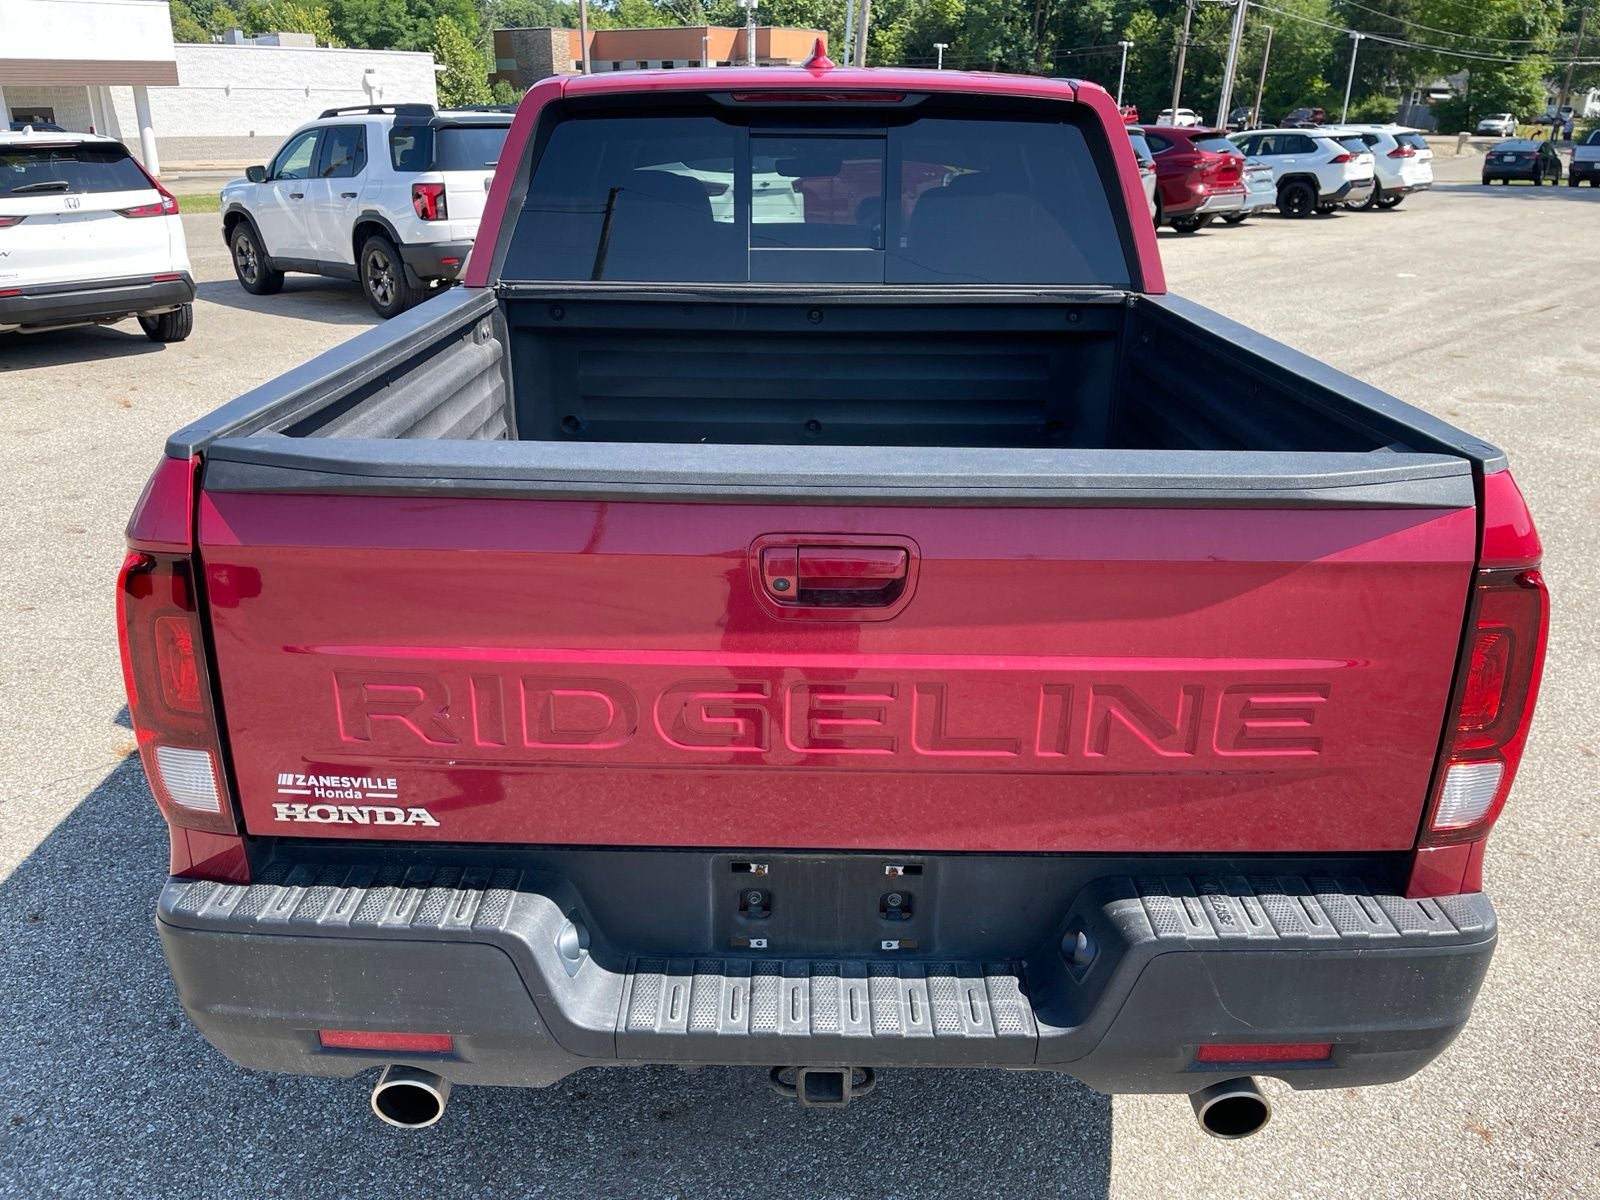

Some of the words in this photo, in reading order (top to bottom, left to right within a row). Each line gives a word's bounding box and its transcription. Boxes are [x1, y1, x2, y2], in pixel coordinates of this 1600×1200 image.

[332, 669, 1331, 757] RIDGELINE
[294, 774, 398, 790] ZANESVILLE
[314, 788, 363, 800] Honda
[272, 803, 441, 827] HONDA
